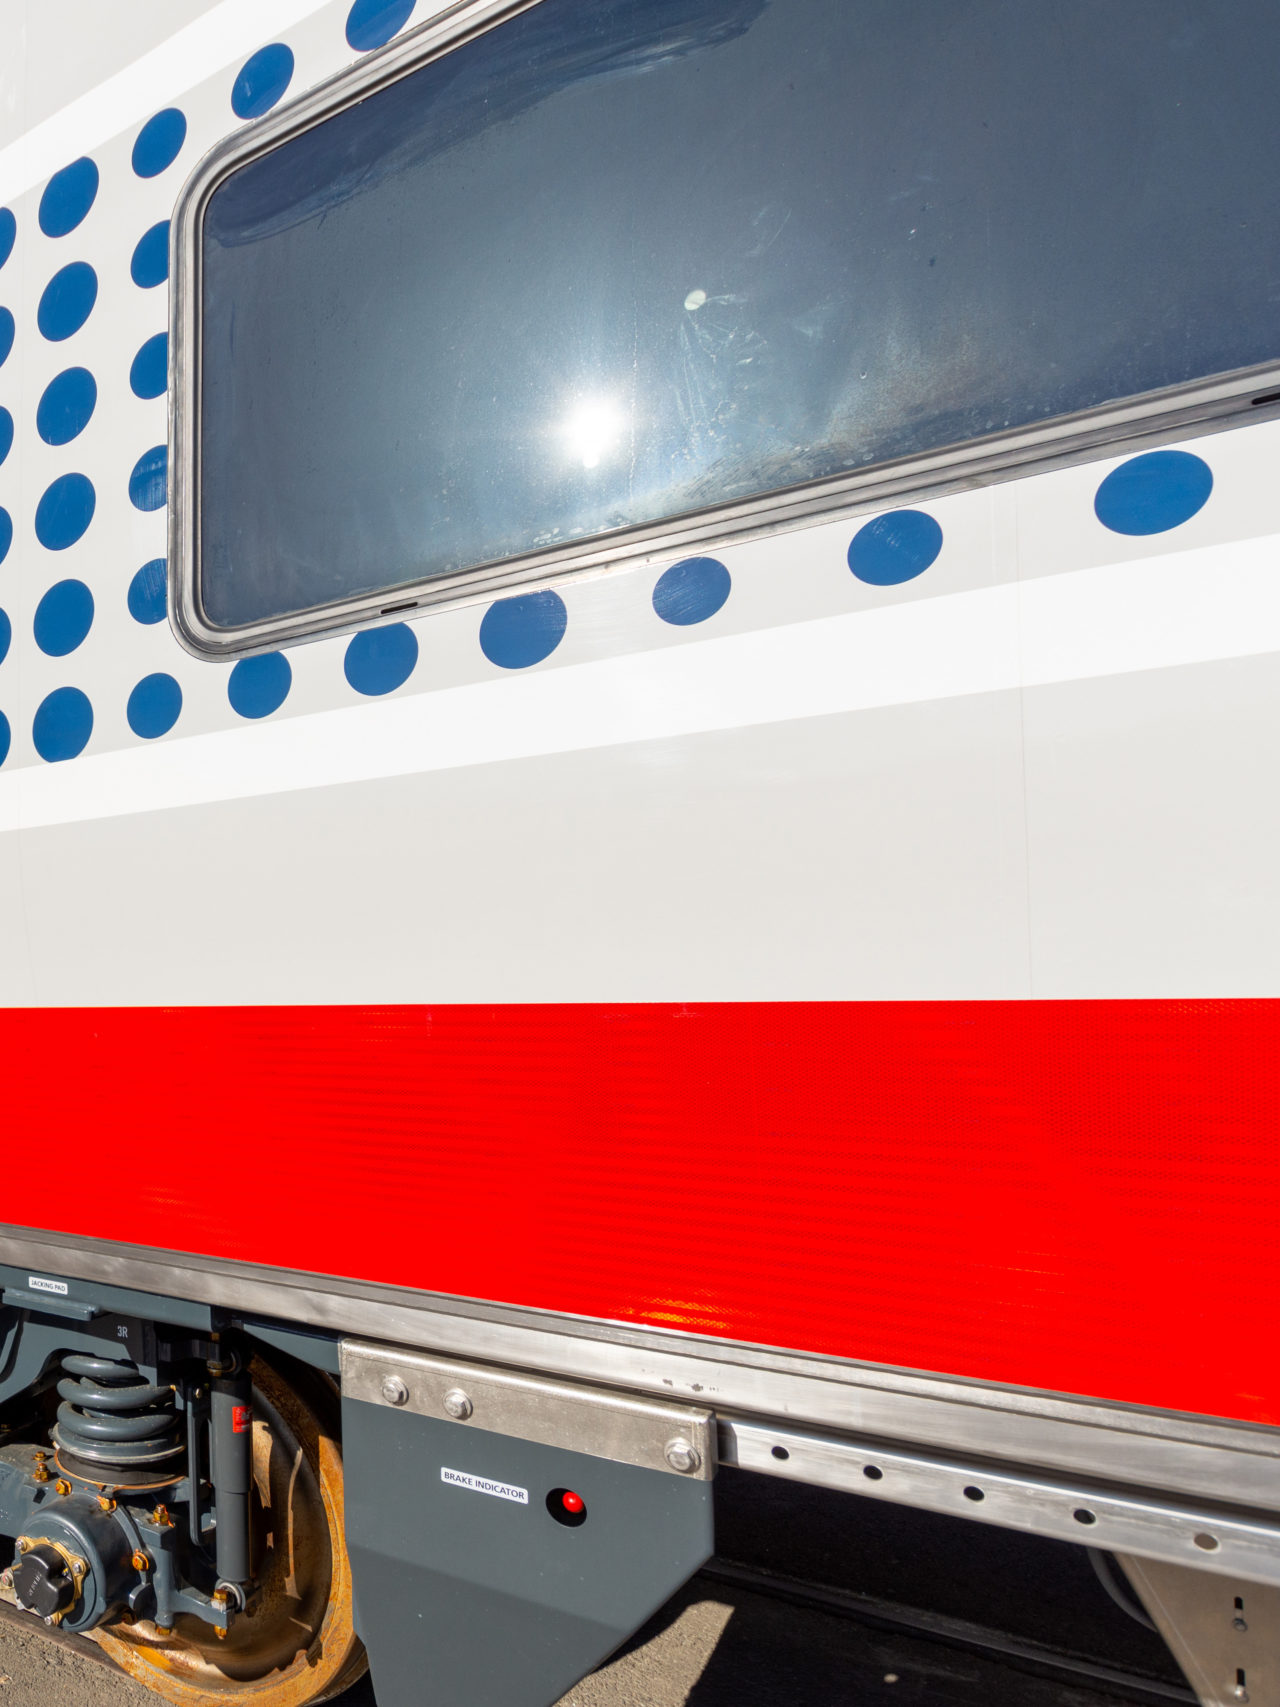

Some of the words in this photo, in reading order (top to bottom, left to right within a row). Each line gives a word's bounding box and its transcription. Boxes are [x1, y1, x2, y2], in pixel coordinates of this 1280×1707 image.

[31, 1280, 54, 1290] JACKING
[54, 1284, 66, 1292] PAD
[117, 1325, 129, 1339] 3R
[444, 1471, 473, 1486] BRAKE
[475, 1480, 525, 1500] INDICATOR
